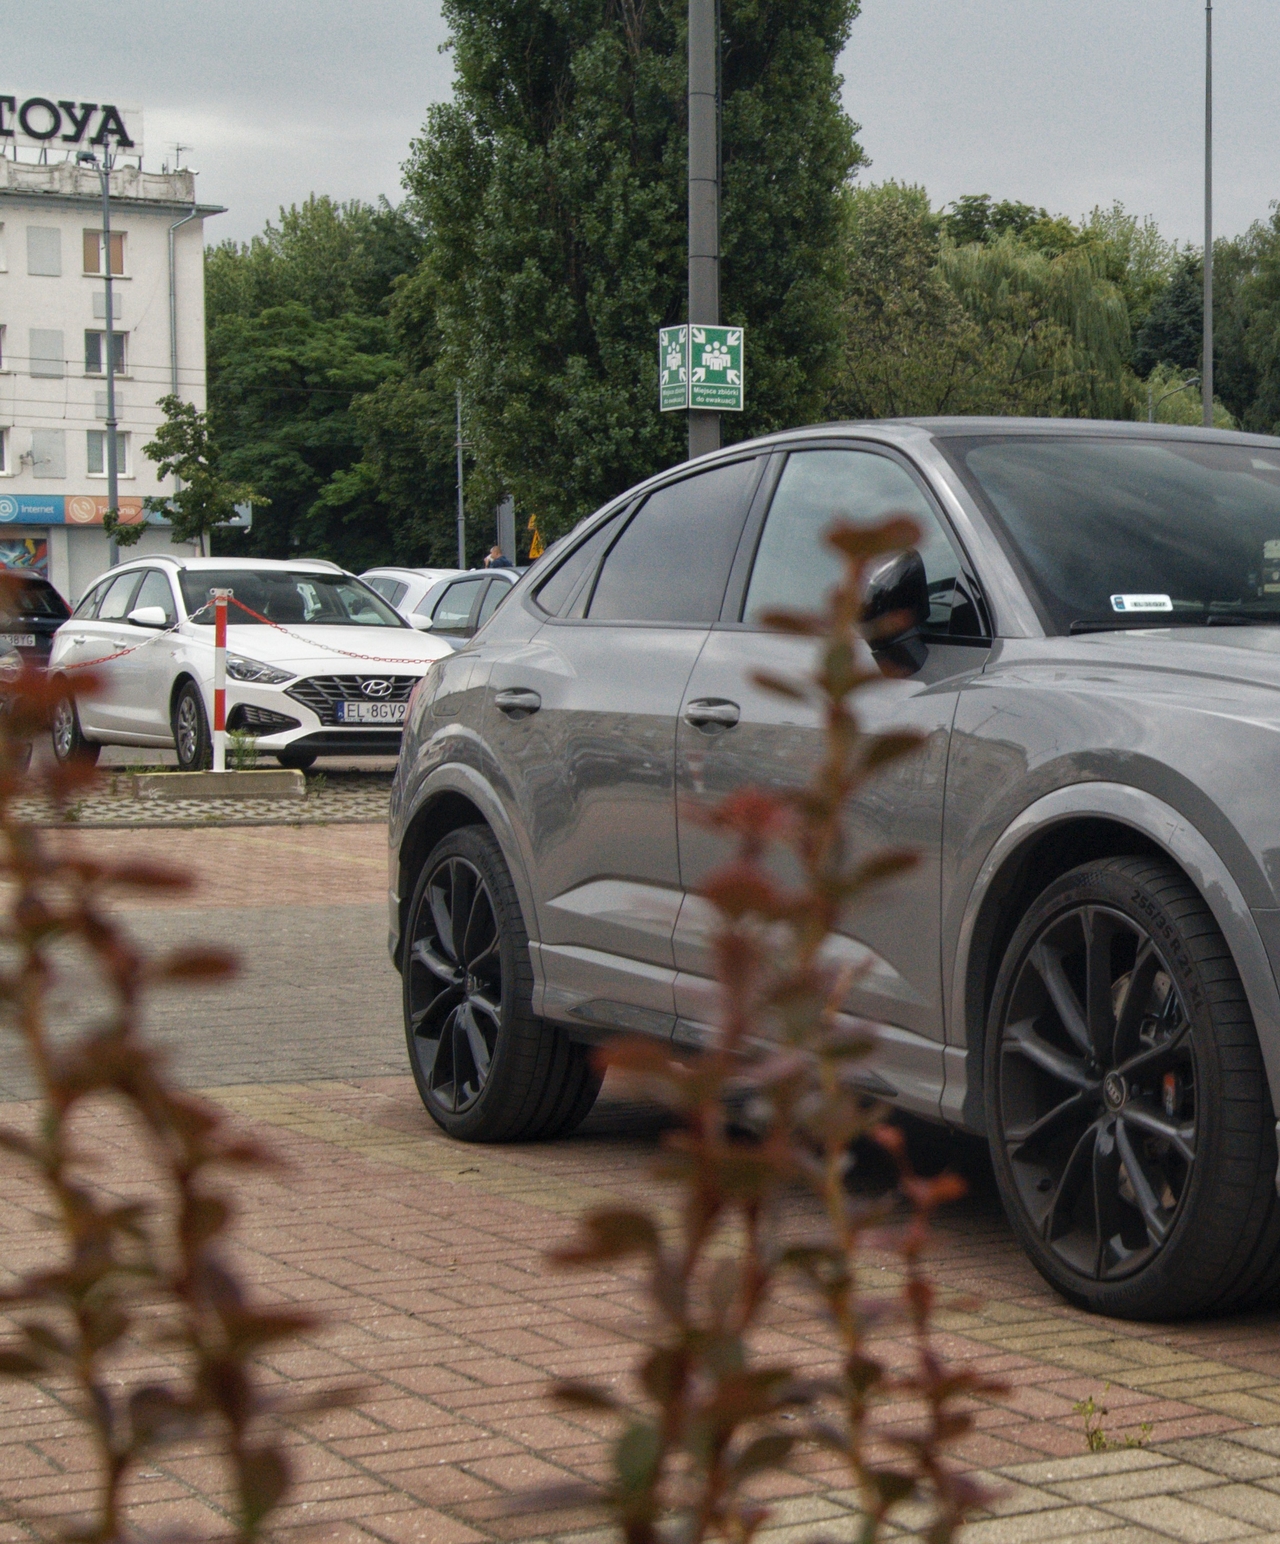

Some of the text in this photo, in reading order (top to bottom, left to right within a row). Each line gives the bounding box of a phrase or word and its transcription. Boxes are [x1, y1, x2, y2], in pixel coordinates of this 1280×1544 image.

[693, 386, 739, 396] Miejsce zbiórki
[705, 397, 736, 405] ewakuacji
[21, 504, 55, 515] Internet
[97, 505, 135, 515] Teonia
[347, 703, 365, 718] EL
[1130, 889, 1174, 940] 255/35
